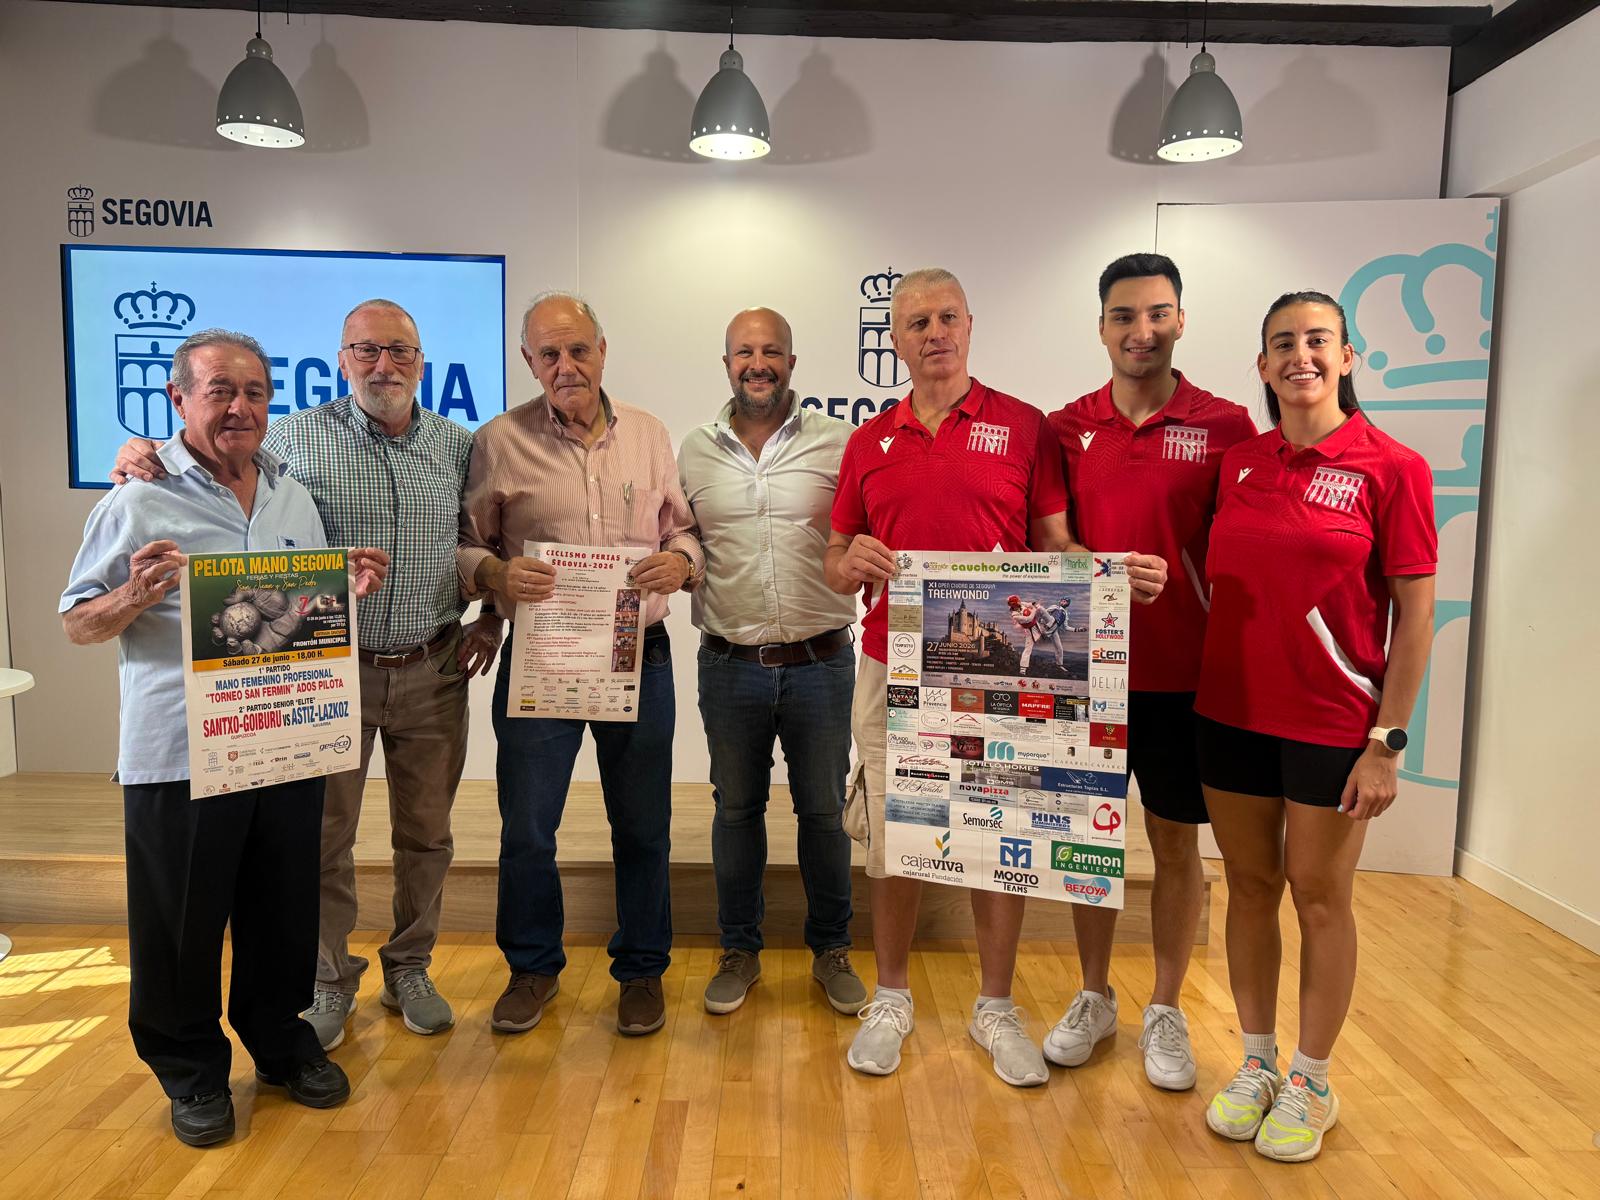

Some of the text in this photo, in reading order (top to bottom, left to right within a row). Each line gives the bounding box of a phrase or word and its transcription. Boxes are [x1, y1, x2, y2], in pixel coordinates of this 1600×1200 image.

[102, 198, 213, 228] SEGOVIA
[267, 357, 479, 422] EGIA
[546, 550, 586, 558] CICLISMO
[194, 553, 344, 576] PELOTA MANO SEGOVIA
[552, 559, 614, 569] SEGOVIA-2026
[928, 589, 989, 600] TAEKWONDO
[319, 636, 347, 645] MUNICIPAL
[927, 642, 939, 652] 27
[223, 658, 250, 667] Sábado
[251, 656, 261, 665] 27
[262, 655, 270, 663] de
[272, 654, 290, 664] junio
[297, 651, 316, 660] 18,00
[1092, 648, 1126, 660] stem
[266, 665, 290, 674] PARTIDO
[216, 668, 333, 691] MANO FEMENINO PROFESIONAL
[1092, 676, 1125, 689] DELTA
[245, 688, 260, 700] SAN
[297, 681, 317, 693] ADOS
[319, 678, 344, 690] PILOTA
[247, 703, 271, 712] PARTIDO
[273, 700, 294, 710] SENIOR
[203, 701, 349, 738] SANTXO-GOIBURU VS ASTIZ-LAZKOZ
[1005, 764, 1039, 772] HOMES
[960, 784, 1009, 795] novapizza
[963, 813, 1003, 829] Semorsec
[1032, 812, 1071, 824] HINS
[901, 854, 964, 874] cajaviva
[1056, 861, 1121, 875] INGENIERIA
[903, 870, 963, 883] cajarural Fundación
[994, 870, 1039, 885] MOOTO
[1003, 882, 1028, 894] TEAMS
[1065, 883, 1108, 896] BEZOYA
